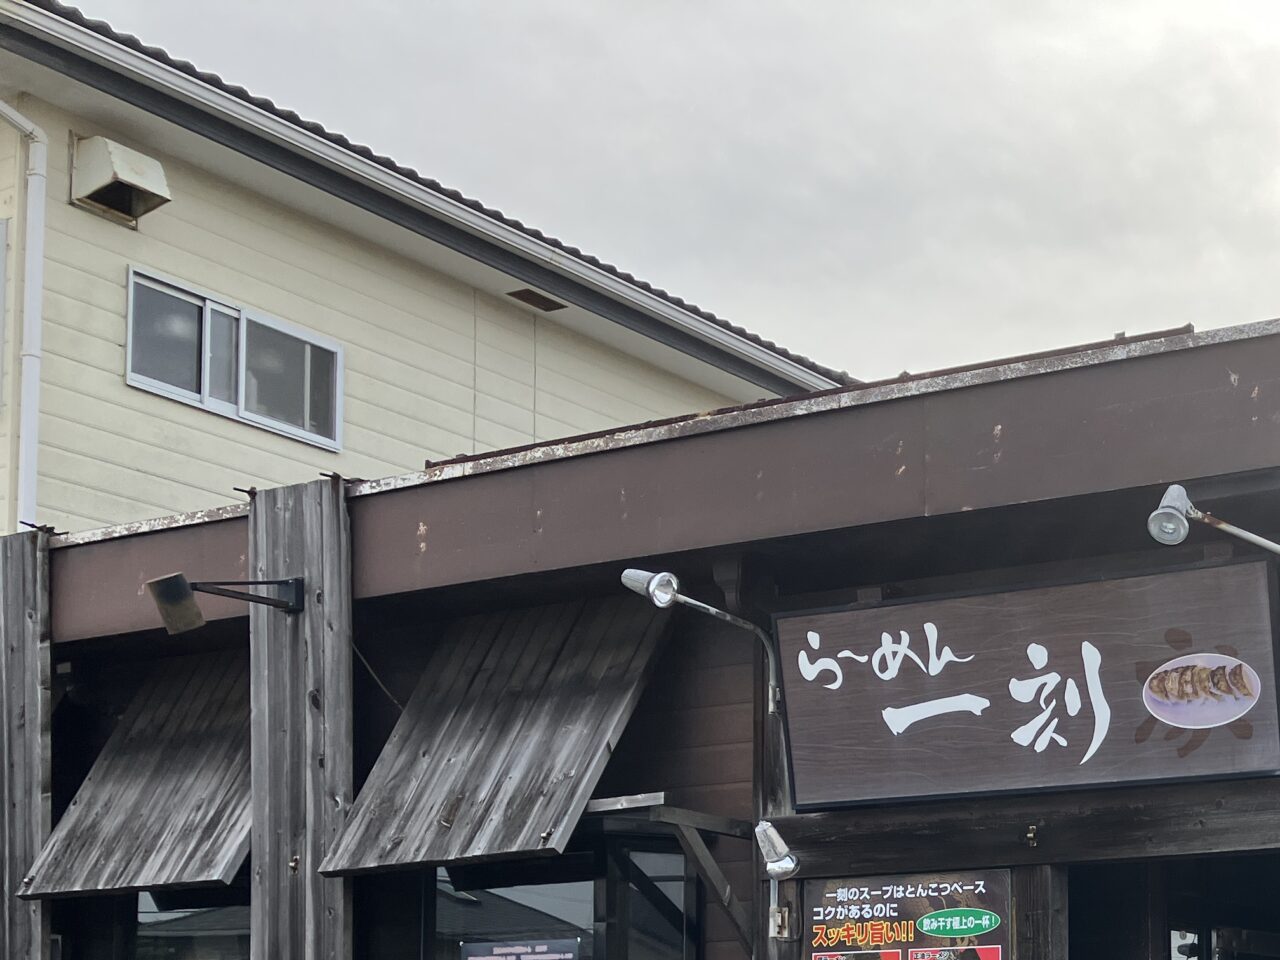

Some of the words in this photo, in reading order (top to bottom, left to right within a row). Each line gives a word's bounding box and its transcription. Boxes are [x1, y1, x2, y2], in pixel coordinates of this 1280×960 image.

[882, 640, 1112, 766] 一刻
[825, 880, 986, 902] 一刻のスープはとんこつベース
[812, 903, 898, 921] コクがあるのに
[912, 951, 950, 960] 正油ラーメン
